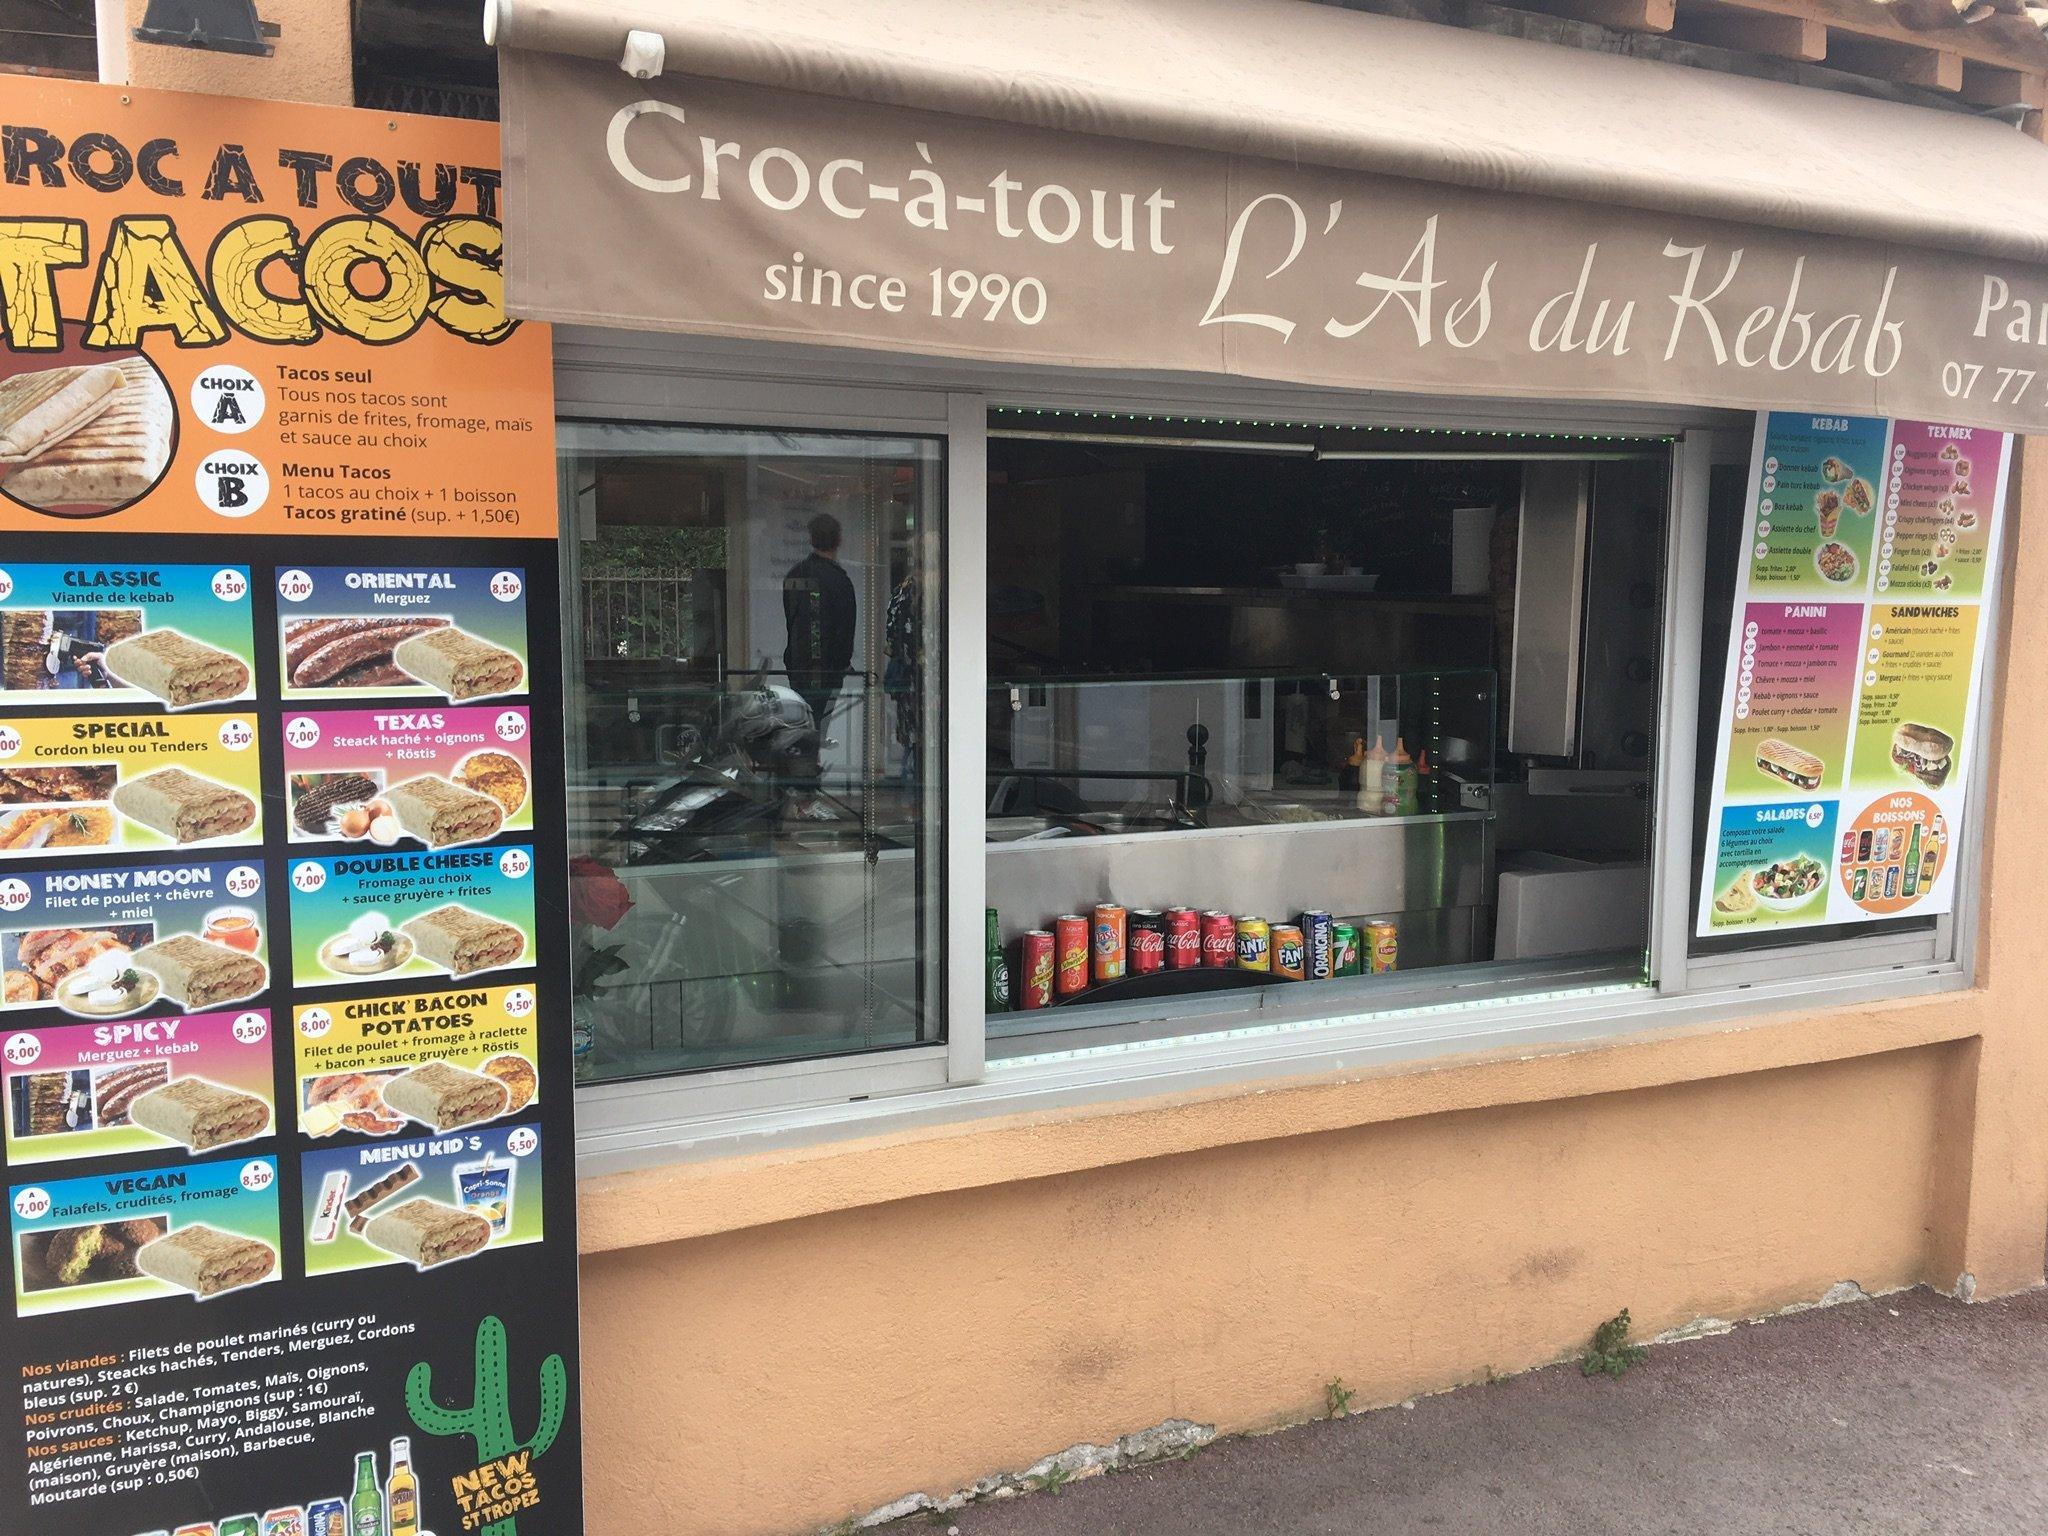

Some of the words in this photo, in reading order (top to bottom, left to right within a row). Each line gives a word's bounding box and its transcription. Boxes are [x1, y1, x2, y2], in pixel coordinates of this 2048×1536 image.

[1, 124, 186, 197] ROC
[203, 143, 264, 203] A
[278, 148, 502, 217] TOUT
[606, 100, 1175, 254] Croc-à-tout
[0, 214, 521, 351] TACOS
[763, 251, 906, 312] since
[930, 267, 1047, 325] 1990
[1529, 243, 1636, 355] du
[1663, 237, 1905, 377] Kebab
[277, 365, 330, 383] Tacos
[335, 368, 372, 384] seul
[1942, 361, 1984, 399] 07
[1992, 367, 2036, 404] 77
[200, 377, 255, 391] CHOIX
[278, 386, 320, 403] Tous
[326, 390, 356, 405] nos
[360, 391, 407, 407] tacos
[411, 393, 448, 408] sont
[212, 393, 246, 424] A
[279, 409, 332, 428] garnis
[338, 409, 359, 426] de
[364, 410, 412, 429] frites,
[416, 412, 490, 434] fromage,
[495, 416, 533, 433] maïs
[1811, 418, 1849, 432] KEBAB
[280, 431, 297, 444] et
[302, 432, 352, 446] sauce
[357, 435, 378, 447] au
[383, 432, 428, 448] choix
[205, 462, 258, 476] CHOIX
[282, 462, 335, 478] Menu
[339, 464, 392, 480] Tacos
[218, 477, 248, 508] B
[283, 483, 292, 498] 1
[299, 485, 345, 499] tacos
[349, 488, 371, 501] au
[375, 486, 421, 502] choix
[424, 490, 434, 500] +
[439, 488, 447, 502] 1
[454, 487, 517, 503] boisson
[283, 505, 337, 521] Tacos
[341, 505, 407, 524] gratiné
[411, 506, 451, 525] (sup.
[456, 511, 467, 522] +
[471, 508, 520, 526] 1,50€)
[63, 570, 162, 587] CLASSIC
[345, 573, 456, 590] ORIENTAL
[52, 592, 104, 603] Viande
[108, 592, 126, 603] de
[129, 591, 175, 603] kebab
[214, 582, 245, 595] 8,50€
[280, 582, 312, 596] 7,00€
[492, 584, 520, 596] 8,50€
[374, 593, 431, 607] Merguez
[1784, 606, 1827, 618] PANINI
[1891, 607, 1959, 618] SANDWICHES
[72, 721, 170, 739] SPECIAL
[374, 713, 446, 731] TEXAS
[497, 724, 525, 736] 8,50€
[222, 732, 253, 746] 8,50€
[288, 730, 318, 743] 7,00€
[333, 735, 378, 748] Steack
[381, 733, 421, 746] haché
[424, 735, 431, 743] +
[435, 732, 485, 745] oignons
[34, 742, 88, 757] Cordon
[92, 742, 124, 755] bleu
[128, 744, 147, 753] ou
[151, 741, 208, 753] Tenders
[385, 751, 393, 759] +
[397, 748, 436, 760] Röstis
[1890, 797, 1912, 808] NOS
[1756, 808, 1806, 822] SALADES
[1872, 810, 1926, 824] BOISSONS
[1722, 829, 1750, 837] Composez
[334, 857, 420, 875] DOUBLE
[423, 852, 494, 870] CHEESE
[502, 860, 529, 873] 8,50€
[45, 872, 130, 893] HONEY
[134, 867, 211, 888] MOON
[228, 878, 260, 892] 9,50€
[294, 873, 325, 887] 7,00€
[358, 876, 415, 890] Fromage
[418, 875, 435, 886] au
[438, 872, 473, 884] choix
[45, 895, 81, 909] Filet
[84, 894, 100, 906] de
[103, 891, 151, 908] poulet
[153, 892, 162, 901] +
[109, 910, 118, 919] +
[121, 906, 153, 918] miel
[1237, 939, 1267, 953] FANTA
[1314, 922, 1328, 977] ORANGINA
[415, 992, 488, 1013] BACON
[506, 999, 533, 1012] 9,50€
[236, 1025, 266, 1039] 9,50€
[300, 1019, 330, 1033] 8,00€
[361, 1012, 474, 1037] POTATOES
[93, 1020, 181, 1047] SPICY
[6, 1045, 40, 1059] 8,00€
[77, 1048, 140, 1063] Merguez
[143, 1047, 152, 1056] +
[155, 1041, 199, 1055] kebab
[509, 1139, 536, 1151] 5,50€
[359, 1142, 426, 1166] MENU
[105, 1172, 187, 1196] VEGAN
[242, 1172, 272, 1186] 8,50€
[17, 1200, 49, 1214] 7,00€
[52, 1200, 112, 1217] Falafels,
[115, 1192, 177, 1210] crudités,
[180, 1186, 239, 1202] fromage
[320, 1189, 336, 1219] kinder
[22, 1370, 94, 1395] natures),
[97, 1363, 157, 1383] Steacks
[160, 1354, 219, 1373] hachés,
[221, 1344, 285, 1364] Tenders,
[288, 1333, 354, 1355] Merguez,
[357, 1322, 416, 1341] Cordons
[28, 1452, 118, 1475] Algérienne,
[120, 1438, 182, 1460] Harissa,
[185, 1430, 232, 1450] Curry,
[234, 1416, 315, 1440] Andalouse,
[318, 1405, 375, 1426] Blanche
[452, 1451, 529, 1498] NEW
[30, 1483, 108, 1506] Moutarde
[110, 1477, 145, 1495] (sup
[147, 1478, 153, 1487] :
[155, 1466, 200, 1487] 0,50€)
[457, 1473, 537, 1513] TACOS
[461, 1512, 480, 1530] ST
[481, 1489, 540, 1522] TROPEZ
